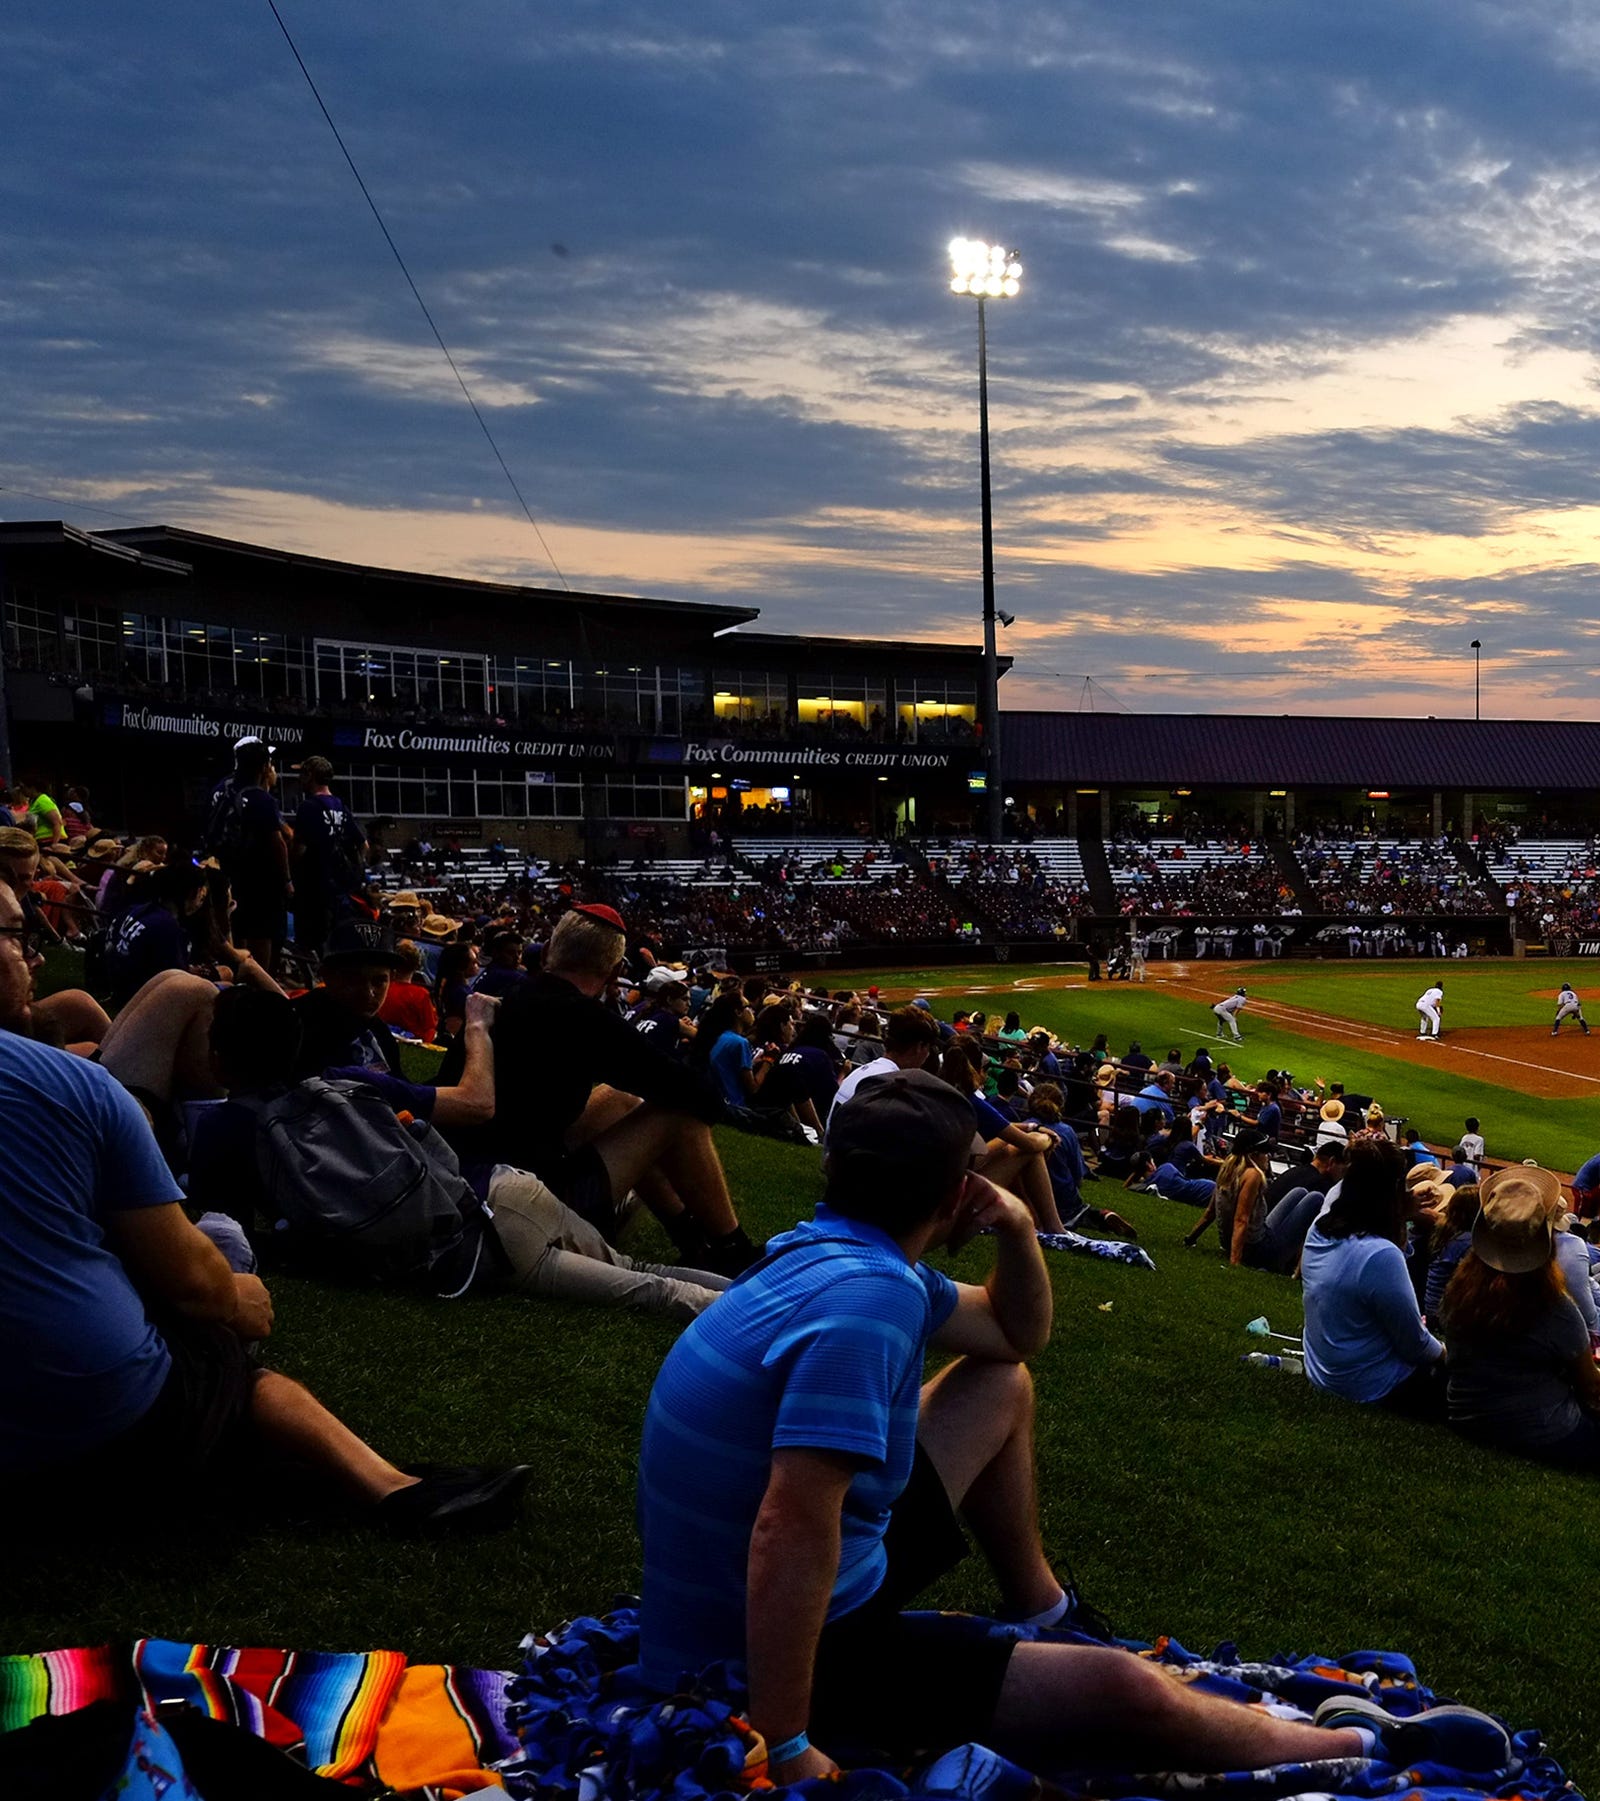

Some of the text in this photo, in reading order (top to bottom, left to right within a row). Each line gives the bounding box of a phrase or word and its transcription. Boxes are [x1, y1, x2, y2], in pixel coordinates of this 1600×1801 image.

[122, 704, 141, 729] Fox
[141, 706, 220, 738] Communities
[268, 726, 304, 743] UNION
[364, 728, 615, 759] Fox Communities CREDIT UNION
[685, 743, 950, 768] Fox Communities CREDIT UNION
